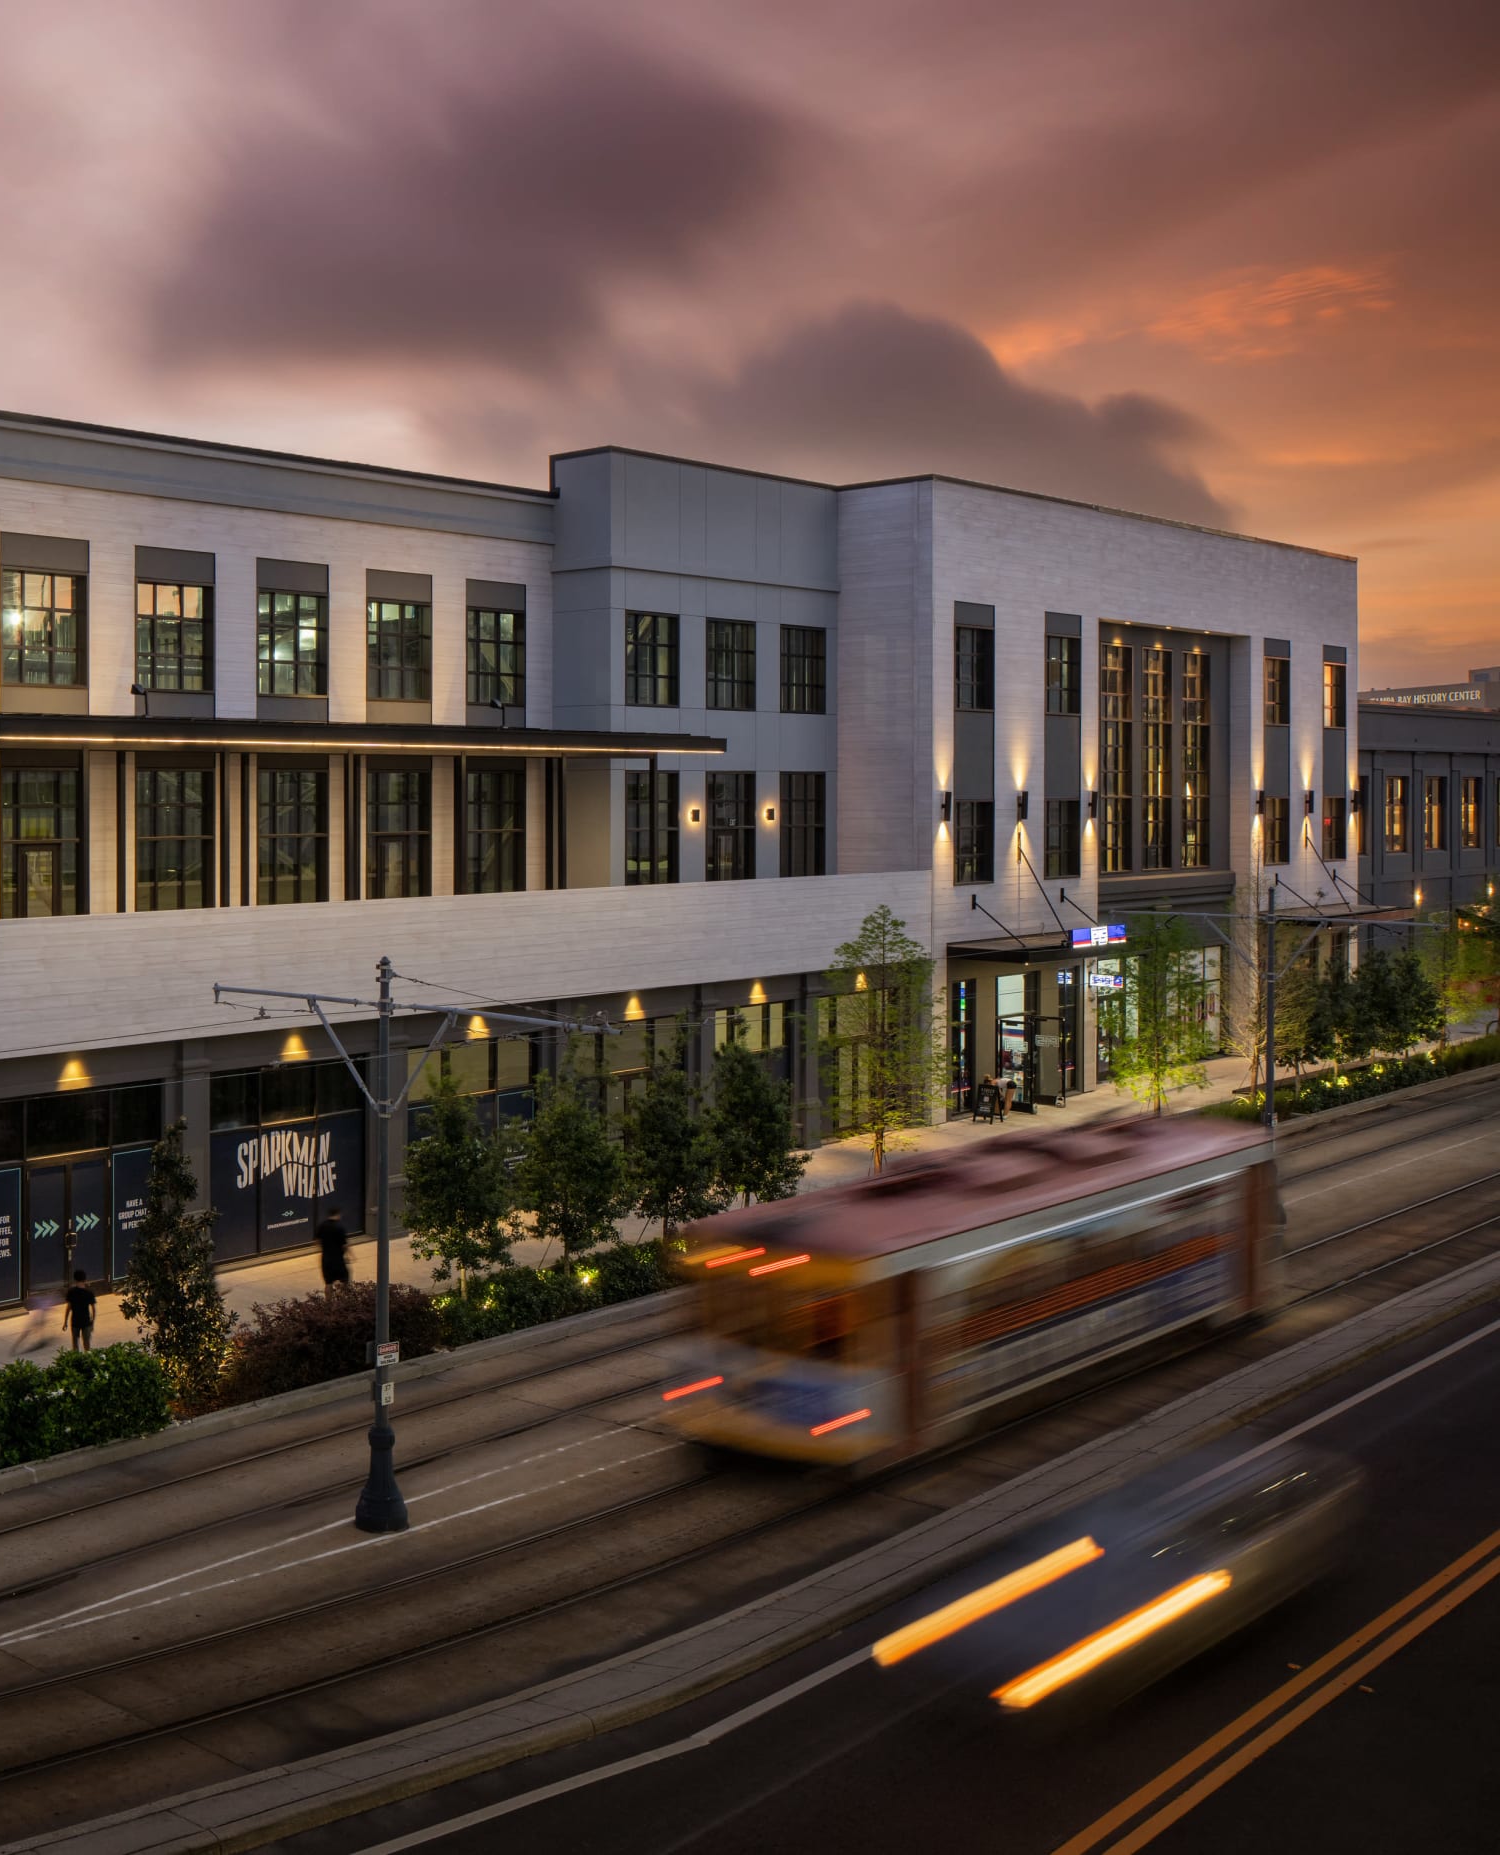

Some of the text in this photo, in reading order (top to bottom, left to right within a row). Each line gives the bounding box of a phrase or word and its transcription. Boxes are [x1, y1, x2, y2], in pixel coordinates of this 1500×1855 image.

[1413, 692, 1448, 704] HISTORY
[1448, 690, 1481, 701] CENTER
[237, 1130, 330, 1189] SPARKMAN
[282, 1161, 336, 1199] WHARF
[0, 1216, 10, 1224] FOR
[118, 1211, 134, 1220] GROUP
[122, 1222, 128, 1230] IN
[0, 1238, 9, 1247] FOR
